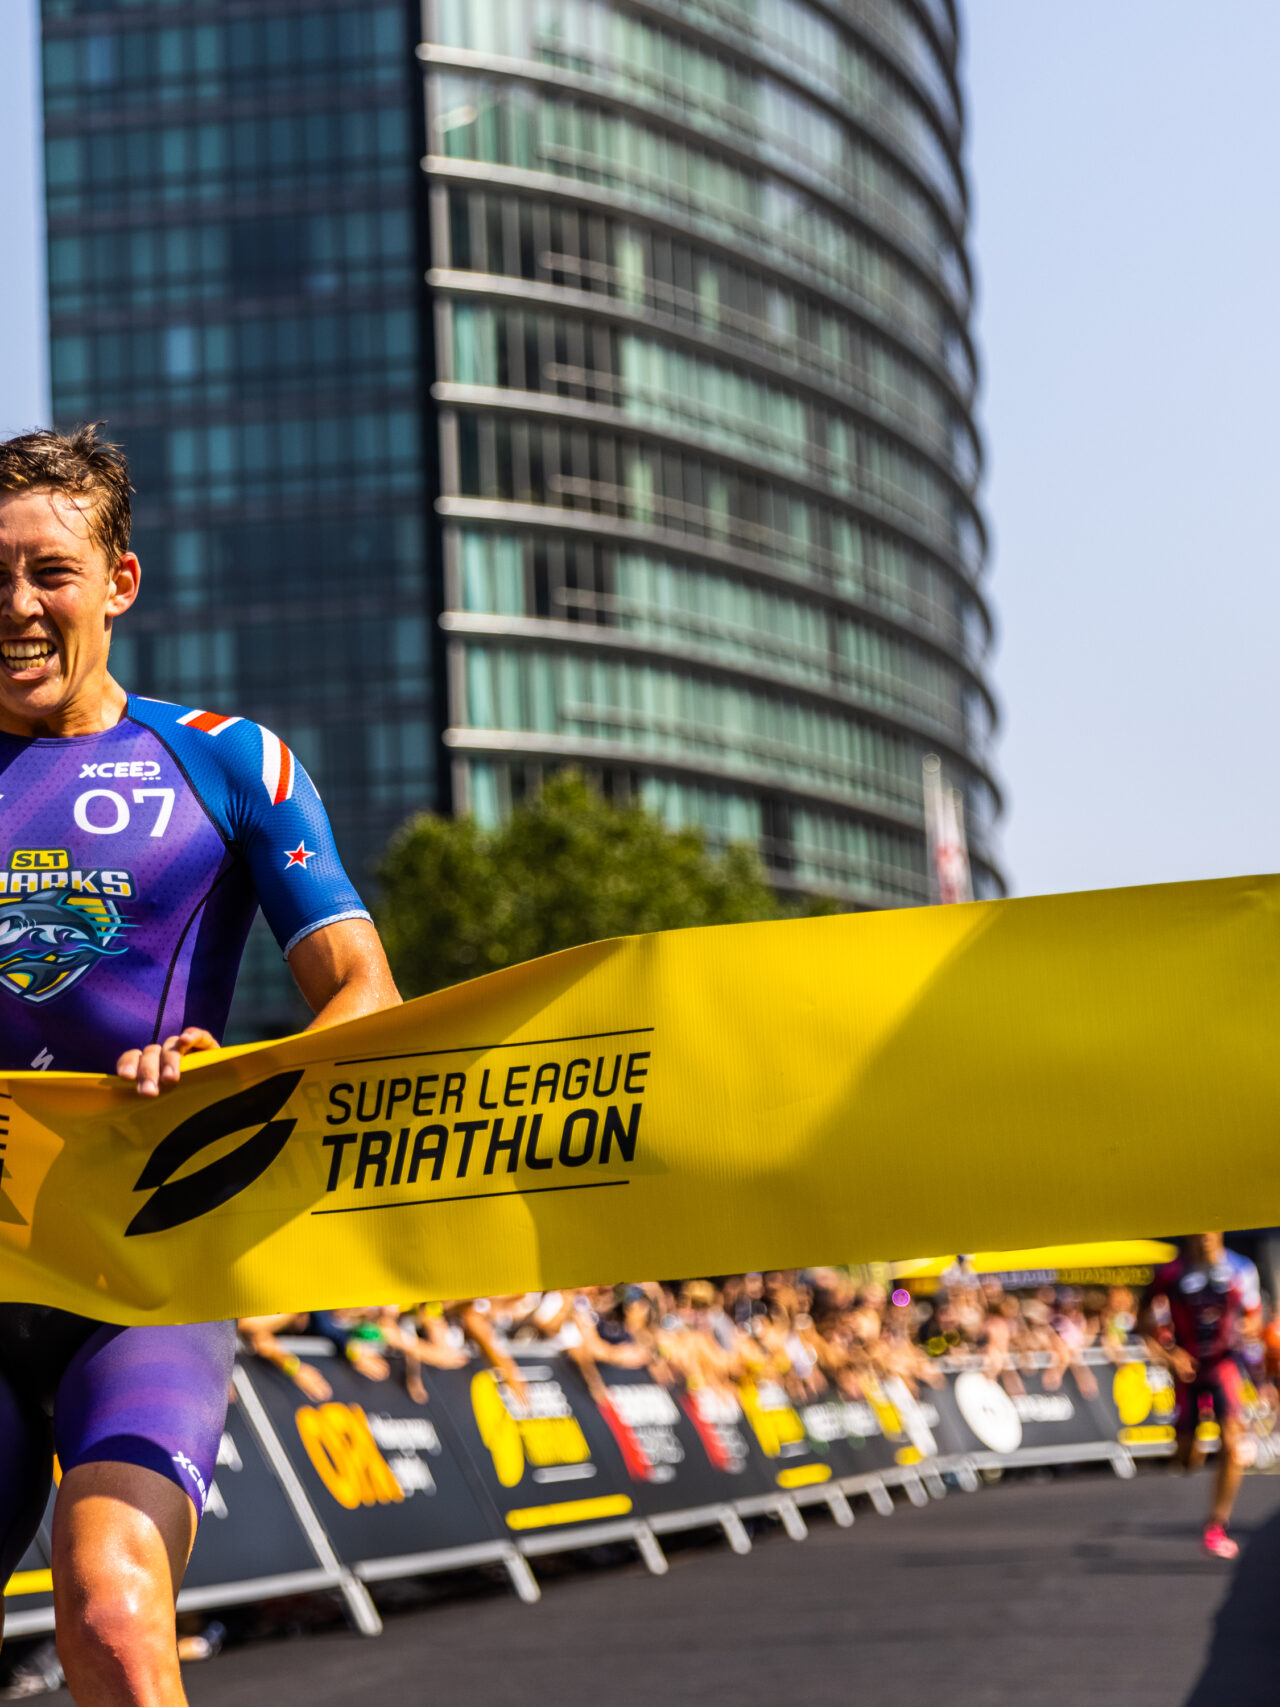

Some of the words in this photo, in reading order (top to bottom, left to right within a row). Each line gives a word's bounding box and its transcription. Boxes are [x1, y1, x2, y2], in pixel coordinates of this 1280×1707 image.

[78, 760, 162, 780] XCEED
[73, 787, 176, 837] 07
[14, 852, 65, 868] SLT
[325, 1072, 467, 1126] SUPER
[478, 1051, 651, 1110] LEAGUE
[321, 1103, 642, 1193] TRIATHLON
